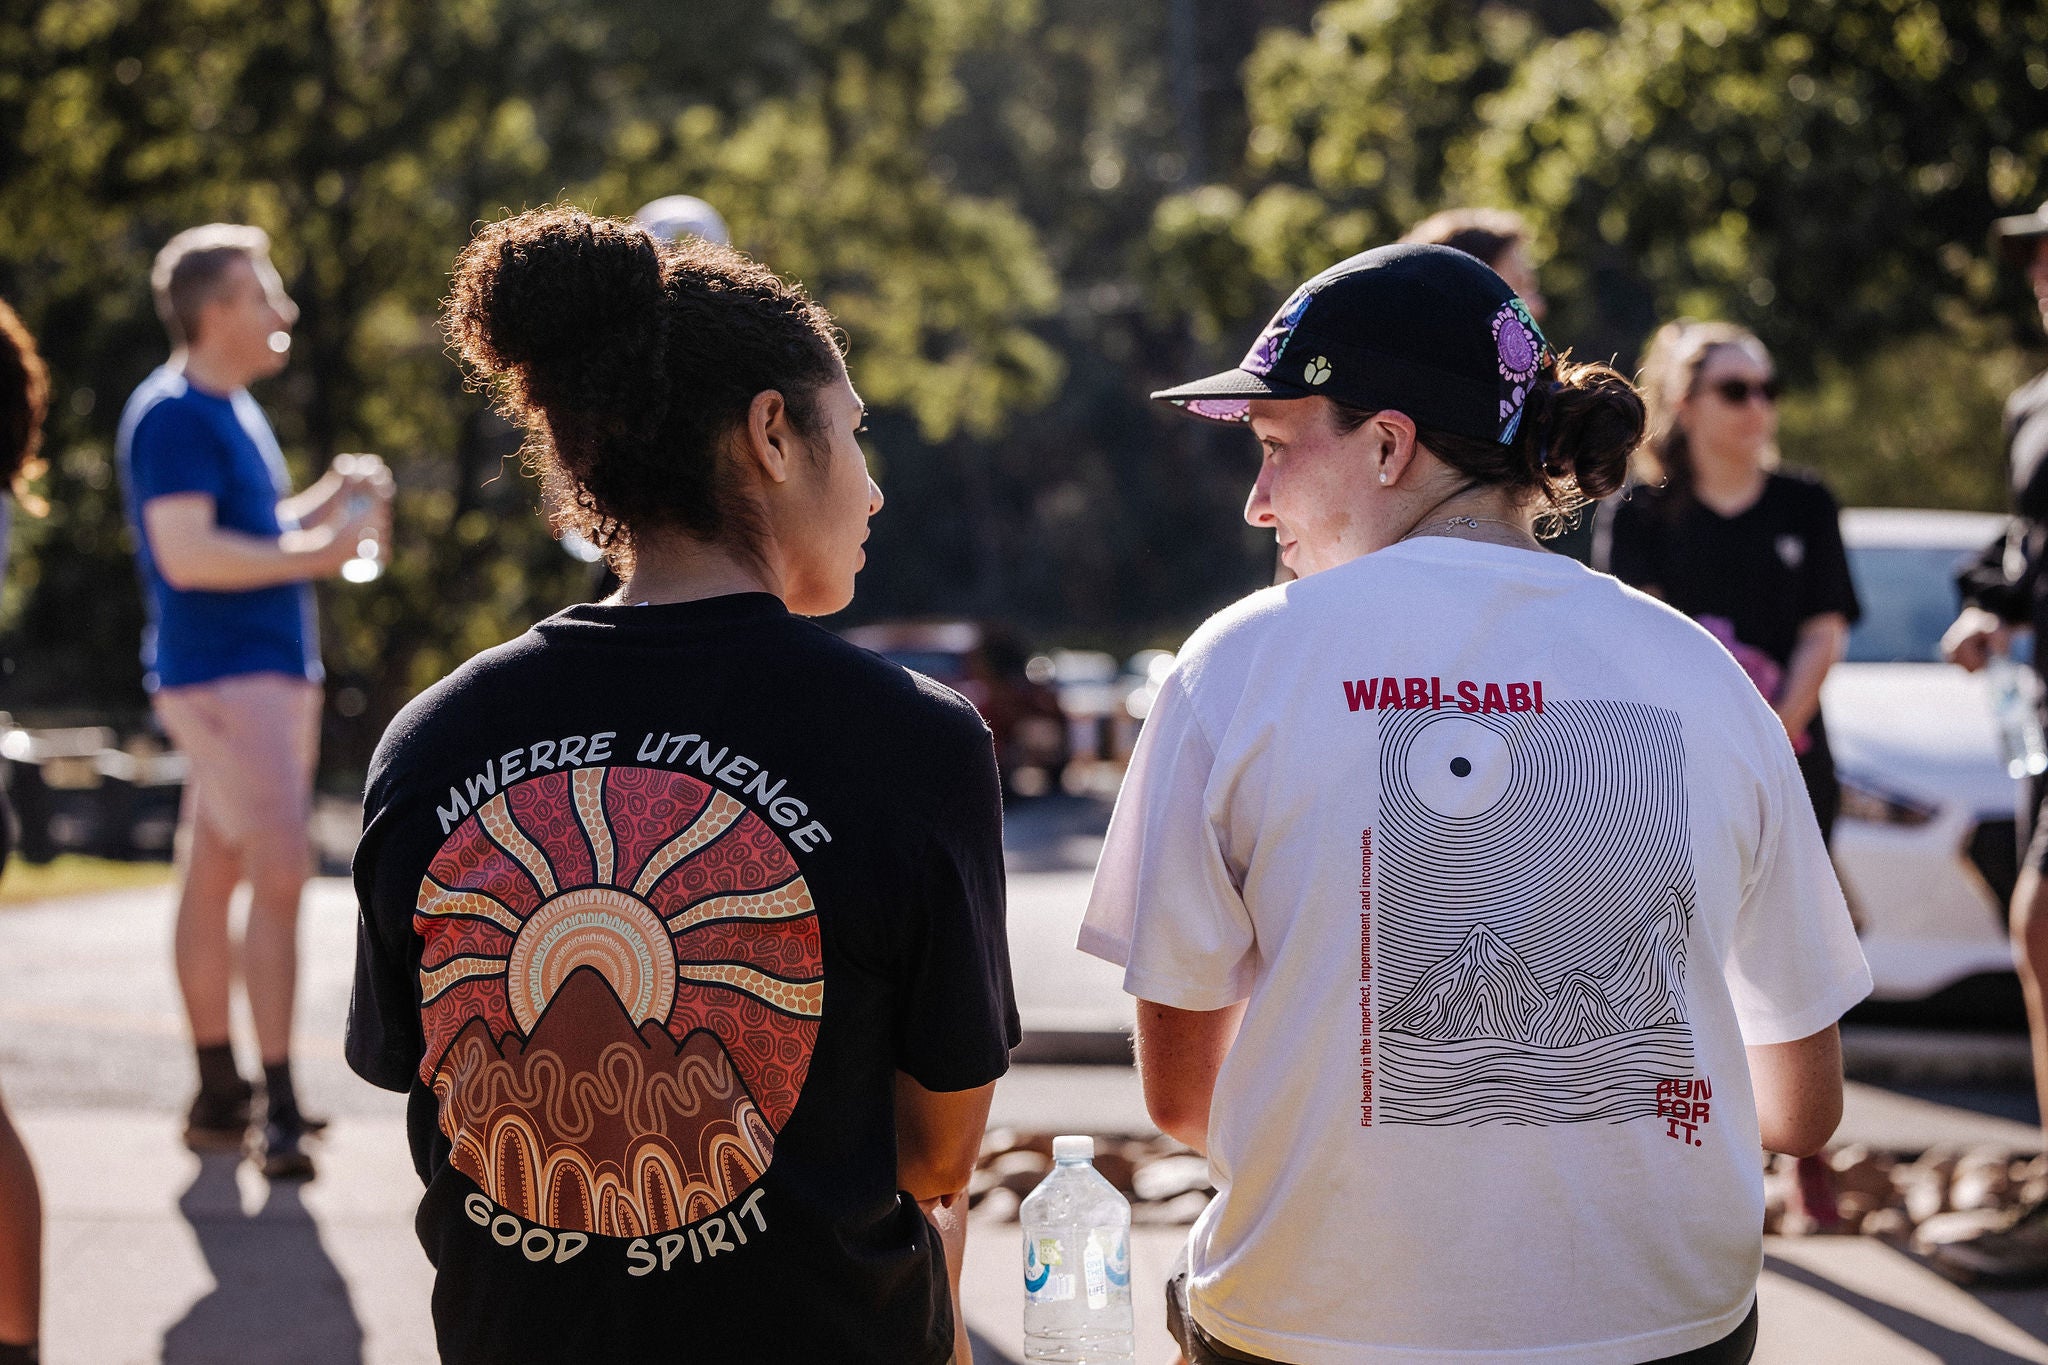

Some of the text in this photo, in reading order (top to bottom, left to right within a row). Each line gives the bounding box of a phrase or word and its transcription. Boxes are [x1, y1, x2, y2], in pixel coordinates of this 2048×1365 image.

[1343, 676, 1544, 715] WABI-SABI
[435, 732, 832, 854] MWERRE UTNENGE
[1359, 826, 1374, 1127] Find beauty in the imperfect, impermanent and incomplete.
[1656, 1075, 1712, 1101] RUN
[1656, 1098, 1710, 1123] FOR
[1666, 1117, 1702, 1147] IT.
[463, 1188, 773, 1277] GOOD SPIRIT
